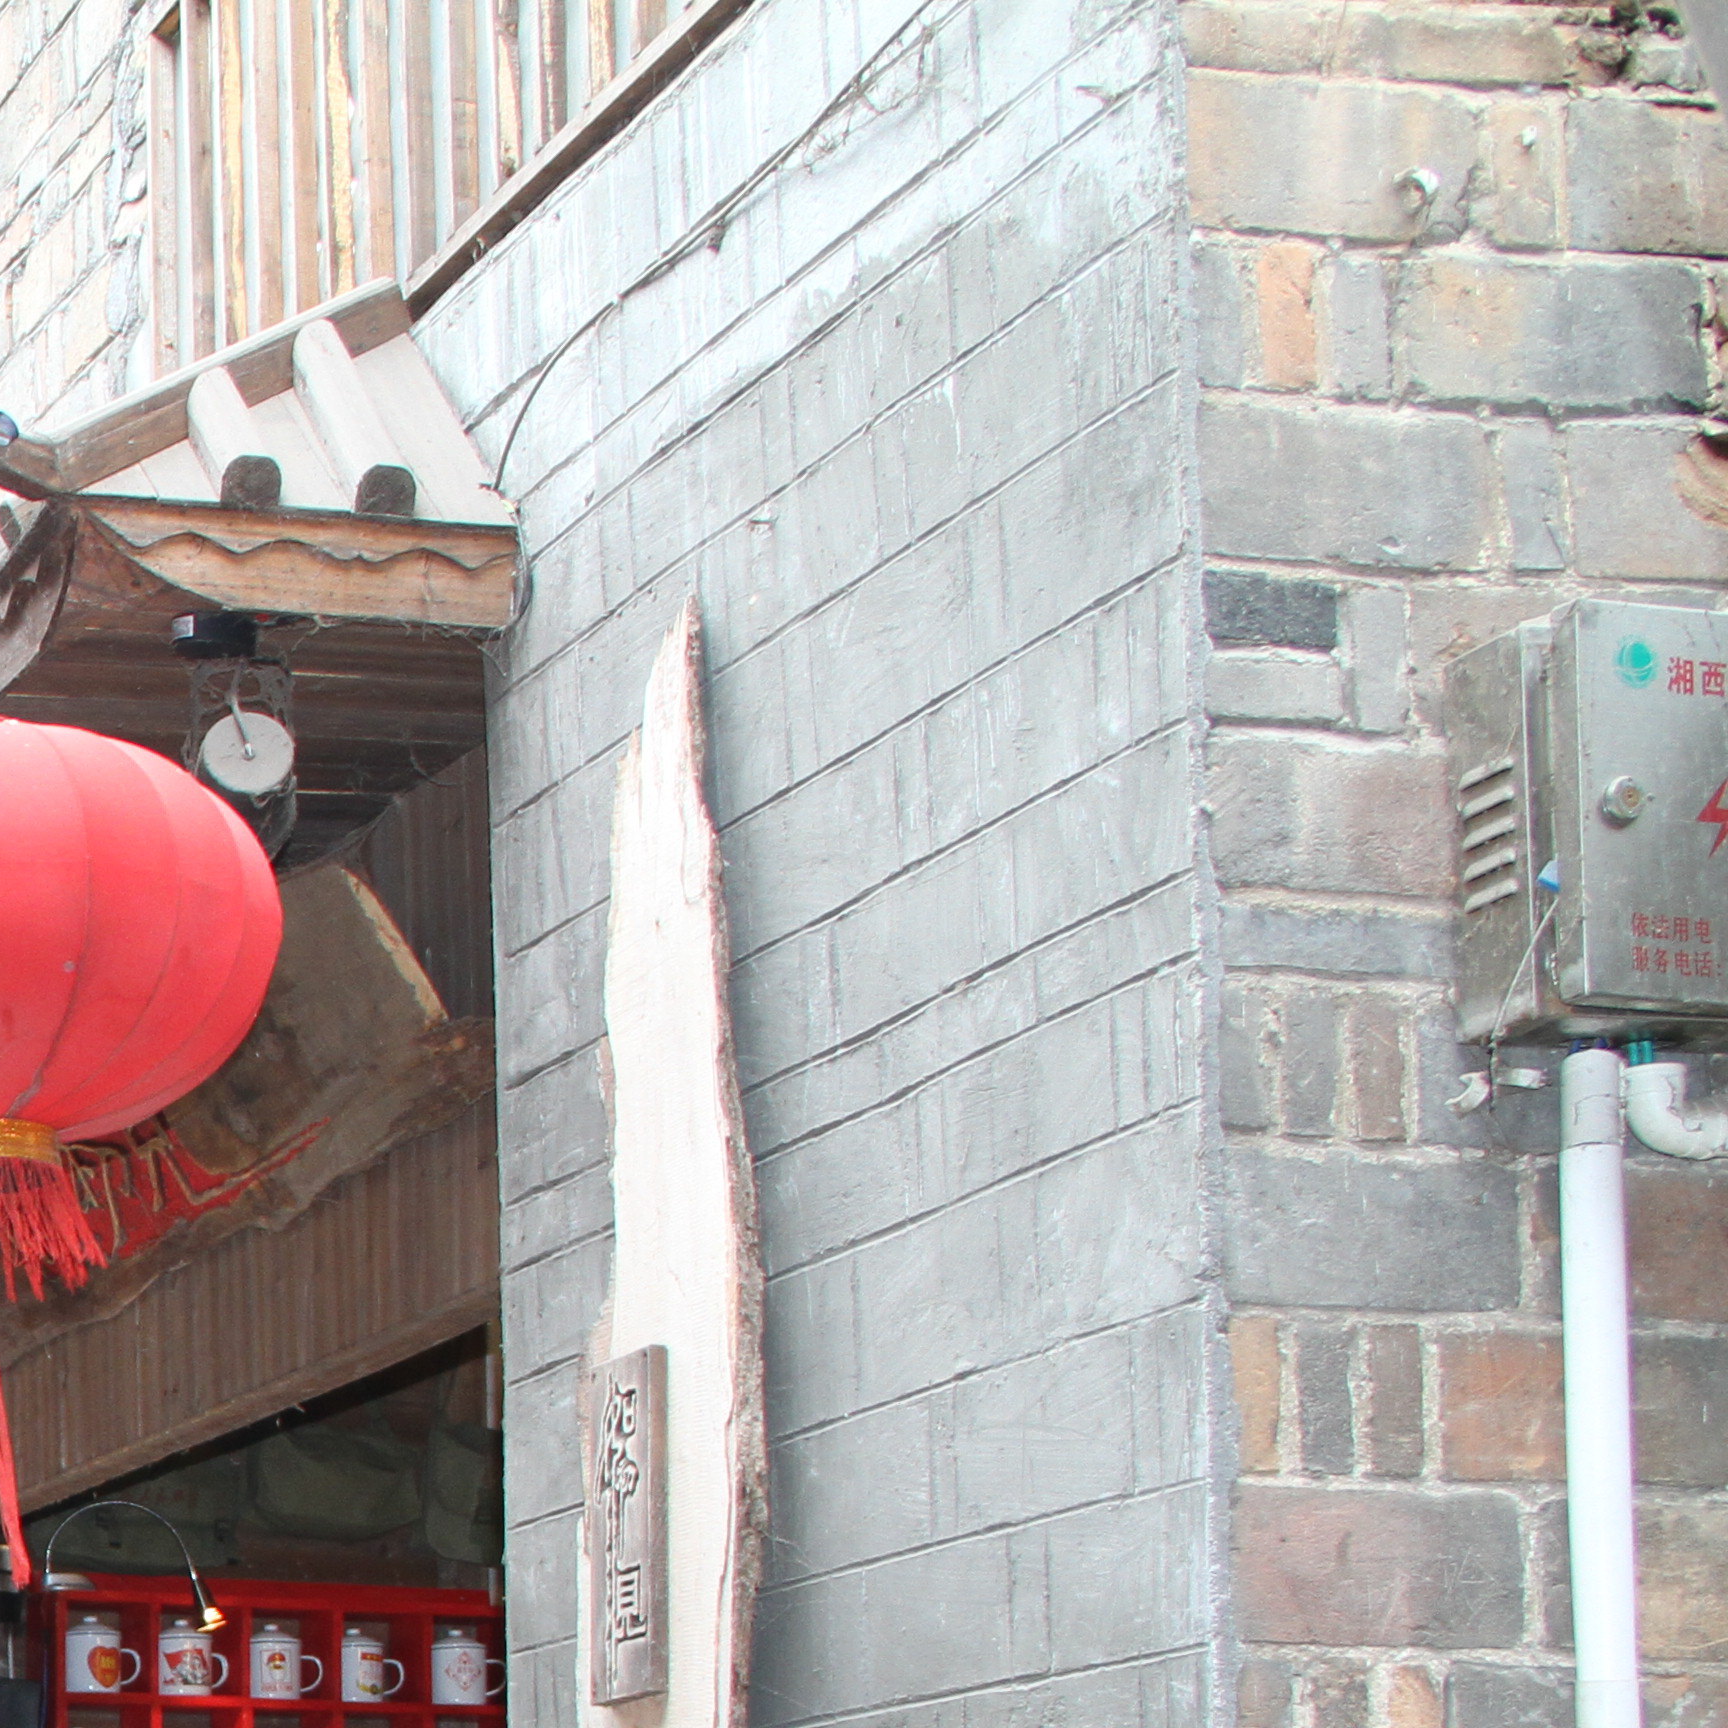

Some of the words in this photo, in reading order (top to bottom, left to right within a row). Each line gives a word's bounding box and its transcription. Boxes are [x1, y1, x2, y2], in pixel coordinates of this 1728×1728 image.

[1666, 656, 1727, 697] 湘西
[1631, 911, 1712, 944] 依法用电
